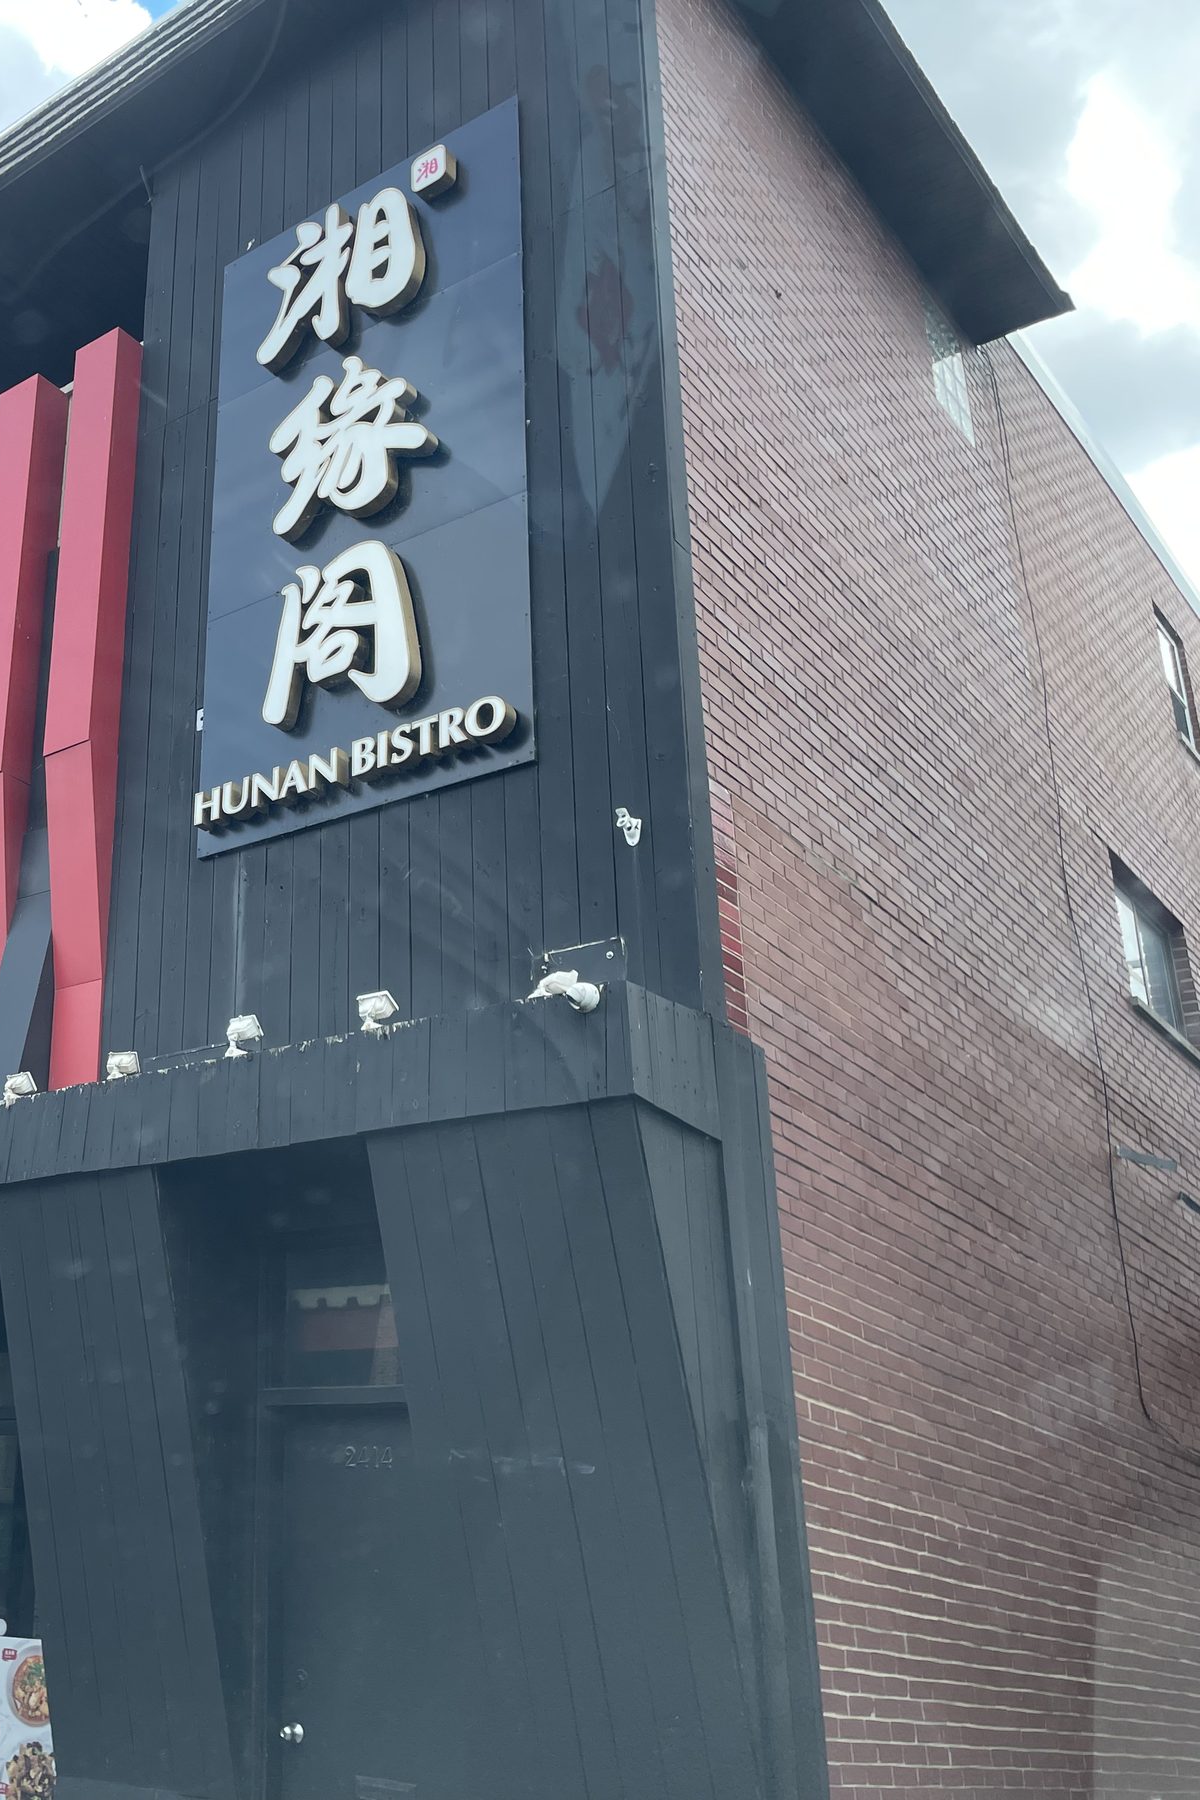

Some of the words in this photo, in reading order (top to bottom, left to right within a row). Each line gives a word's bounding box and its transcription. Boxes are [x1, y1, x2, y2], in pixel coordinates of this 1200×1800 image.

[194, 747, 340, 826] HUNAN
[351, 696, 510, 777] BISTRO
[344, 1446, 393, 1469] 2414
